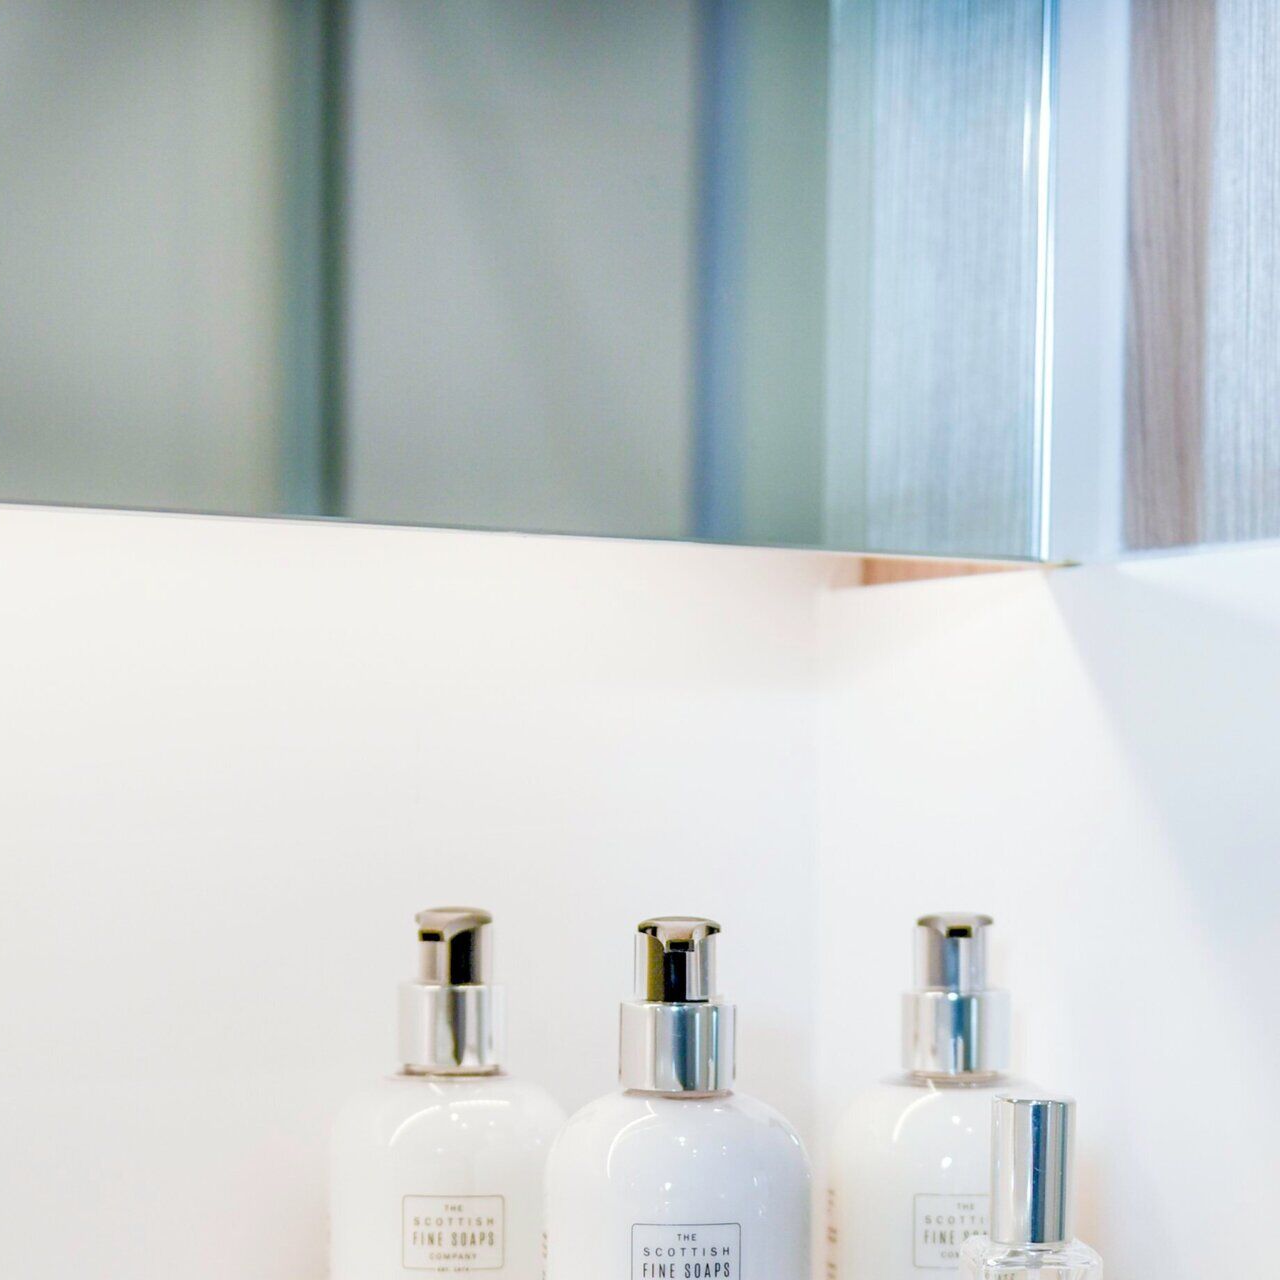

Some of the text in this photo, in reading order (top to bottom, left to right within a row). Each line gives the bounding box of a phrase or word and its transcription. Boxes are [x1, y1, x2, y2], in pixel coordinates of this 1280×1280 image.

[413, 1216, 495, 1228] SCOTTISH
[924, 1214, 985, 1227] SCOTTI
[412, 1230, 495, 1248] FINE SOAPS
[676, 1233, 697, 1242] THE
[923, 1229, 955, 1246] FINE
[429, 1252, 477, 1261] COMPANY
[643, 1246, 730, 1258] SCOTTISH
[642, 1261, 730, 1279] FINE SOAPS
